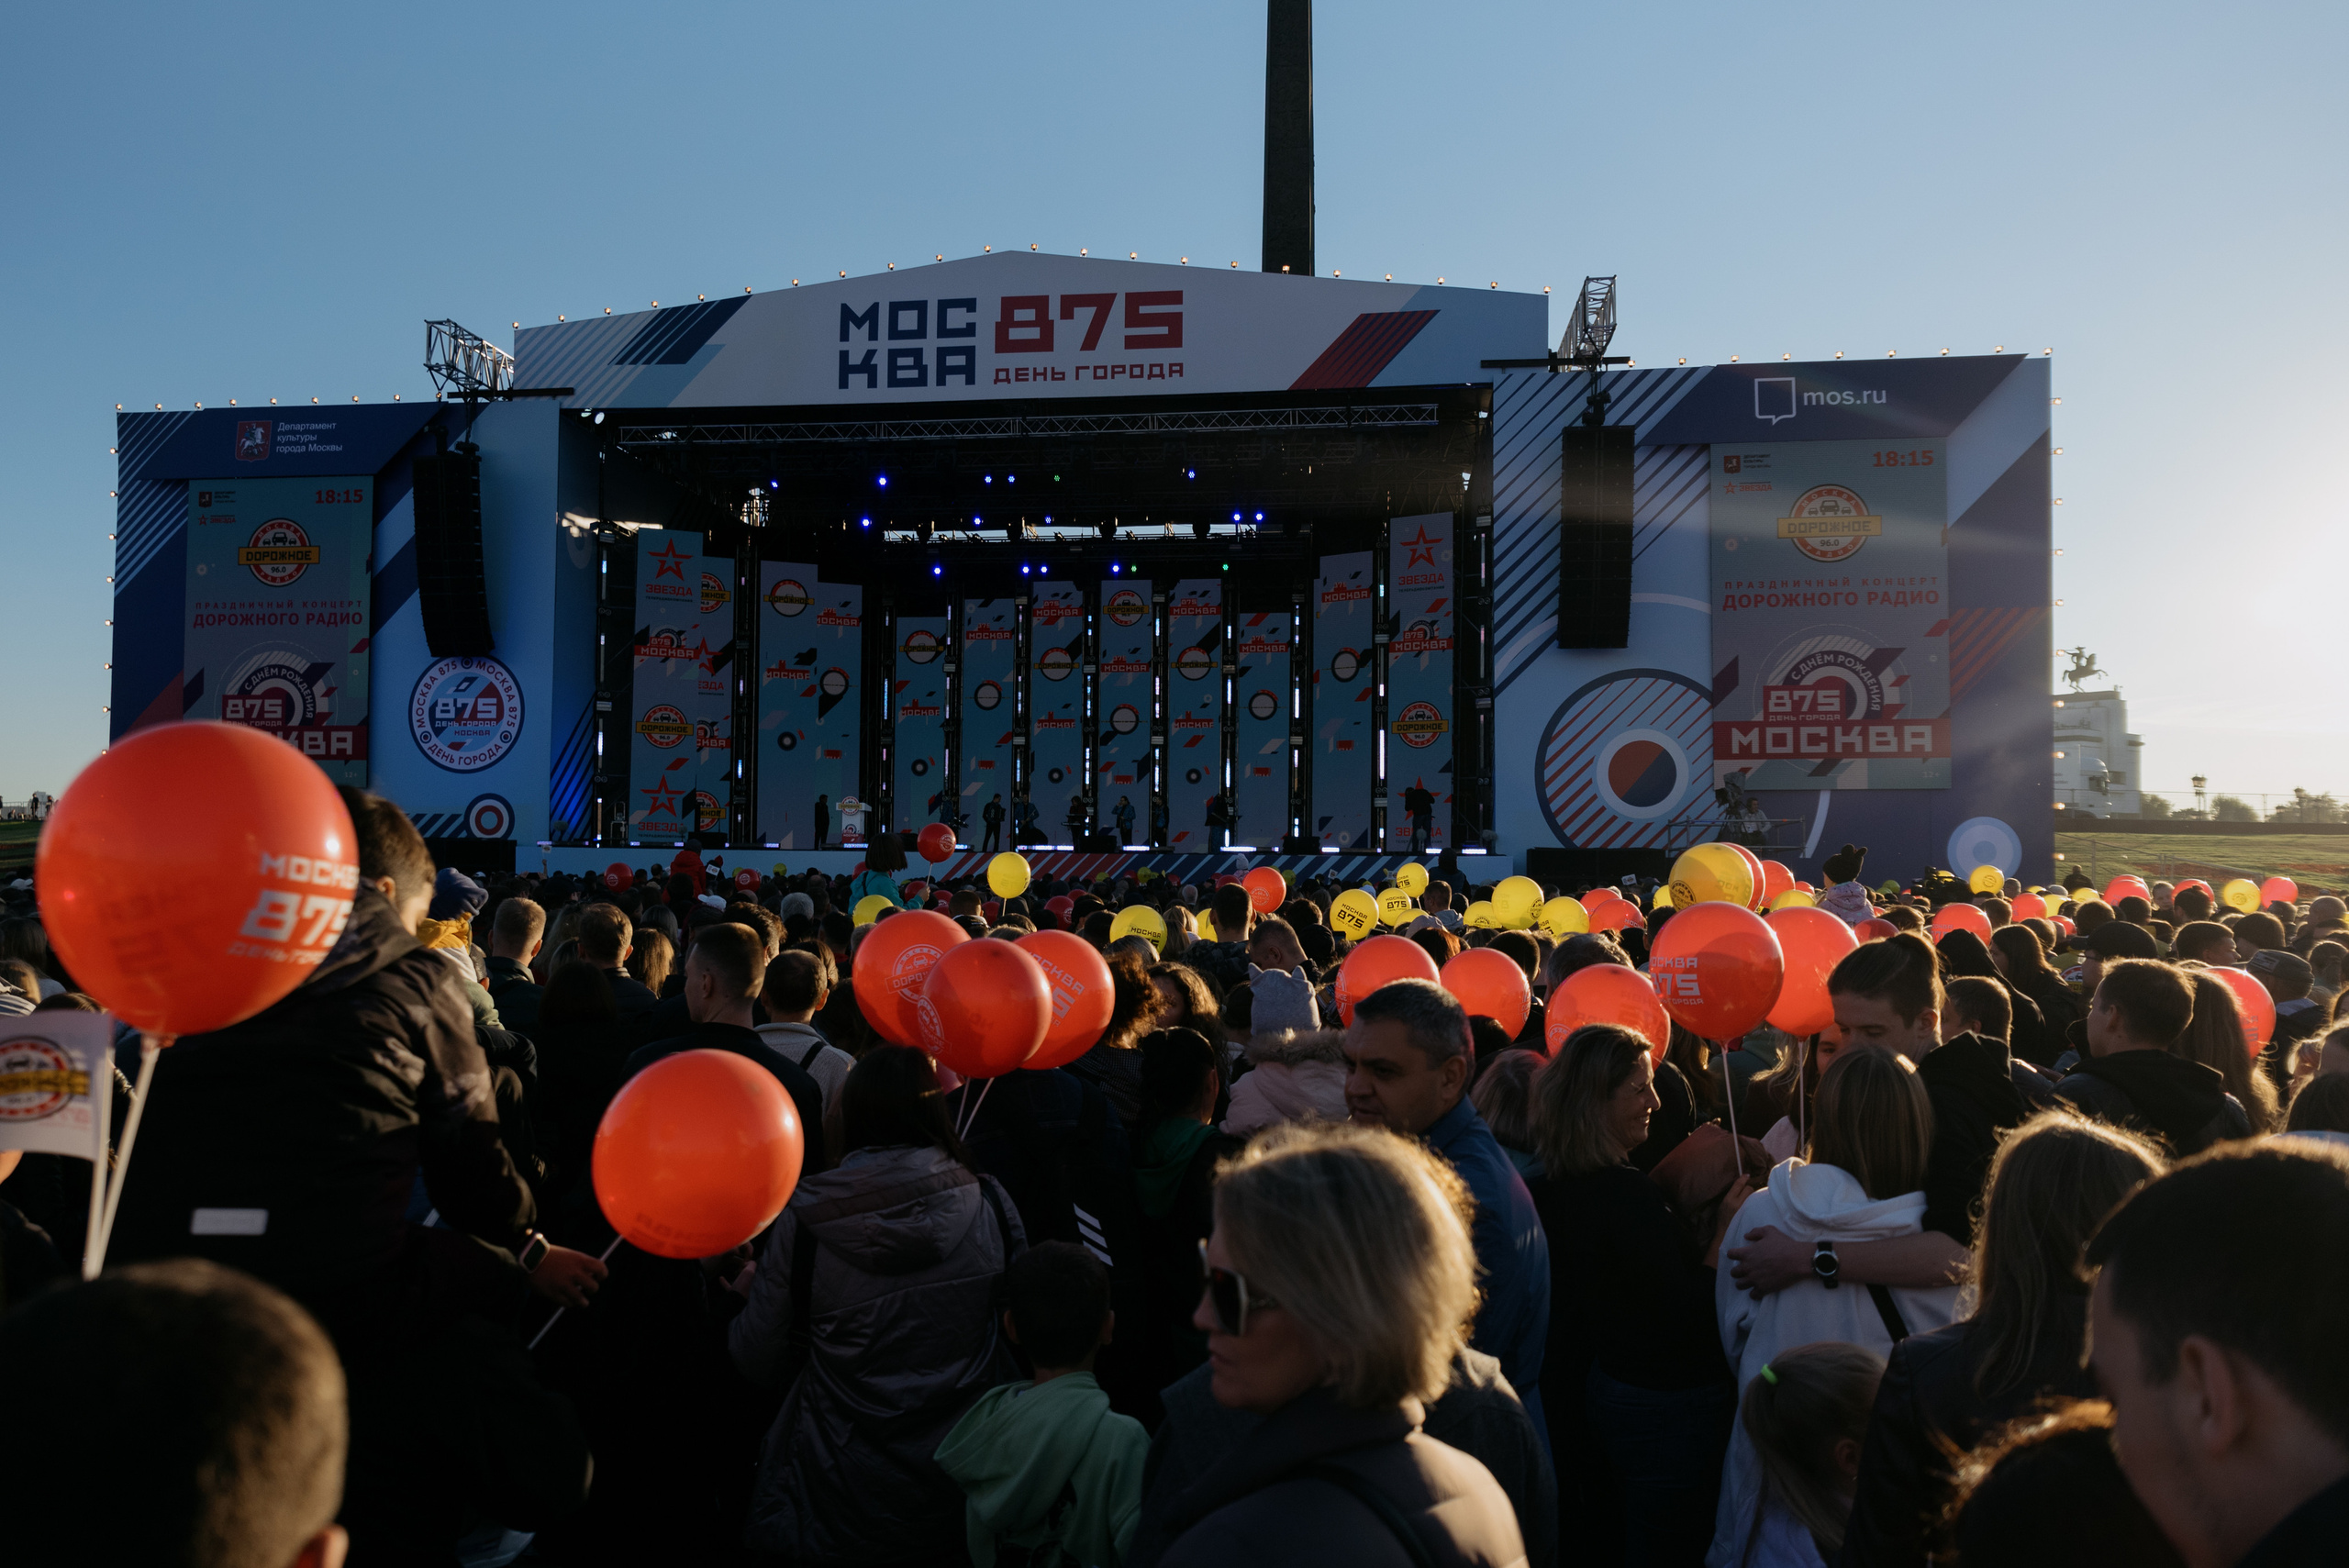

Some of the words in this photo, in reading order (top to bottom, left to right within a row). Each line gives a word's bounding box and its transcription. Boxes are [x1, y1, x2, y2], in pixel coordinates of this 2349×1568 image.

[839, 297, 977, 342] МОС
[995, 290, 1184, 354] 875
[839, 345, 976, 390] КВА
[994, 367, 1066, 384] ДЕНЬ
[1074, 362, 1184, 381] ГОРОДА
[1803, 390, 1887, 406] mos.ru
[277, 422, 337, 432] Департамент
[277, 434, 317, 443] культуры
[276, 446, 306, 454] города
[308, 443, 342, 451] Москвы
[1873, 450, 1933, 467] 18:15
[316, 489, 363, 504] 18:15
[1802, 489, 1857, 506] МОСКВА
[258, 522, 301, 539] МОСКВА
[1787, 521, 1872, 534] ДОРОЖНОЕ
[246, 550, 312, 562] ДОРОЖНОЕ
[1805, 543, 1854, 558] РАДИО
[260, 570, 297, 584] РАДИО
[1398, 573, 1444, 585] ЗВЕЗДА
[1725, 577, 1850, 590] ПРАЗДНИЧНЫЙ
[1862, 576, 1938, 586] КОНЦЕРТ
[646, 584, 692, 595] ЗВЕЗДА
[1325, 591, 1367, 601] МОСКВА
[195, 600, 294, 610] ПРАЗДНИЧНЫЙ
[303, 600, 362, 609] КОНЦЕРТ
[1722, 592, 1858, 611] ДОРОЖНОГО
[1867, 590, 1939, 607] РАДИО
[194, 614, 299, 628] ДОРОЖНОГО
[306, 612, 362, 627] РАДИО
[641, 648, 694, 657] МОСКВА
[1396, 640, 1447, 651] МОСКВА
[1791, 671, 1801, 681] С
[1799, 652, 1834, 674] ДНЁМ
[1837, 653, 1881, 711] РОЖДЕНИЯ
[245, 682, 252, 691] С
[251, 667, 278, 686] ДНЁМ
[281, 668, 314, 718] РОЖДЕНИЯ
[416, 675, 438, 728] МОСКВА
[438, 661, 457, 675] 875
[476, 661, 515, 702] МОСКВА
[507, 706, 518, 728] 875
[226, 699, 282, 718] 875
[435, 698, 496, 718] 875
[1769, 690, 1840, 712] 875
[641, 725, 688, 733] ДОРОЖНОЕ
[1397, 723, 1442, 731] ДОРОЖНОЕ
[1731, 725, 1932, 754] МОСКВА
[428, 743, 454, 763] ДЕНЬ
[458, 744, 503, 765] ГОРОДА
[639, 822, 684, 832] ЗВЕЗД
[1338, 909, 1364, 929] 875
[1341, 903, 1368, 919] МОСКВА
[1131, 928, 1162, 938] МОСКВА
[893, 972, 928, 988] ДОРО
